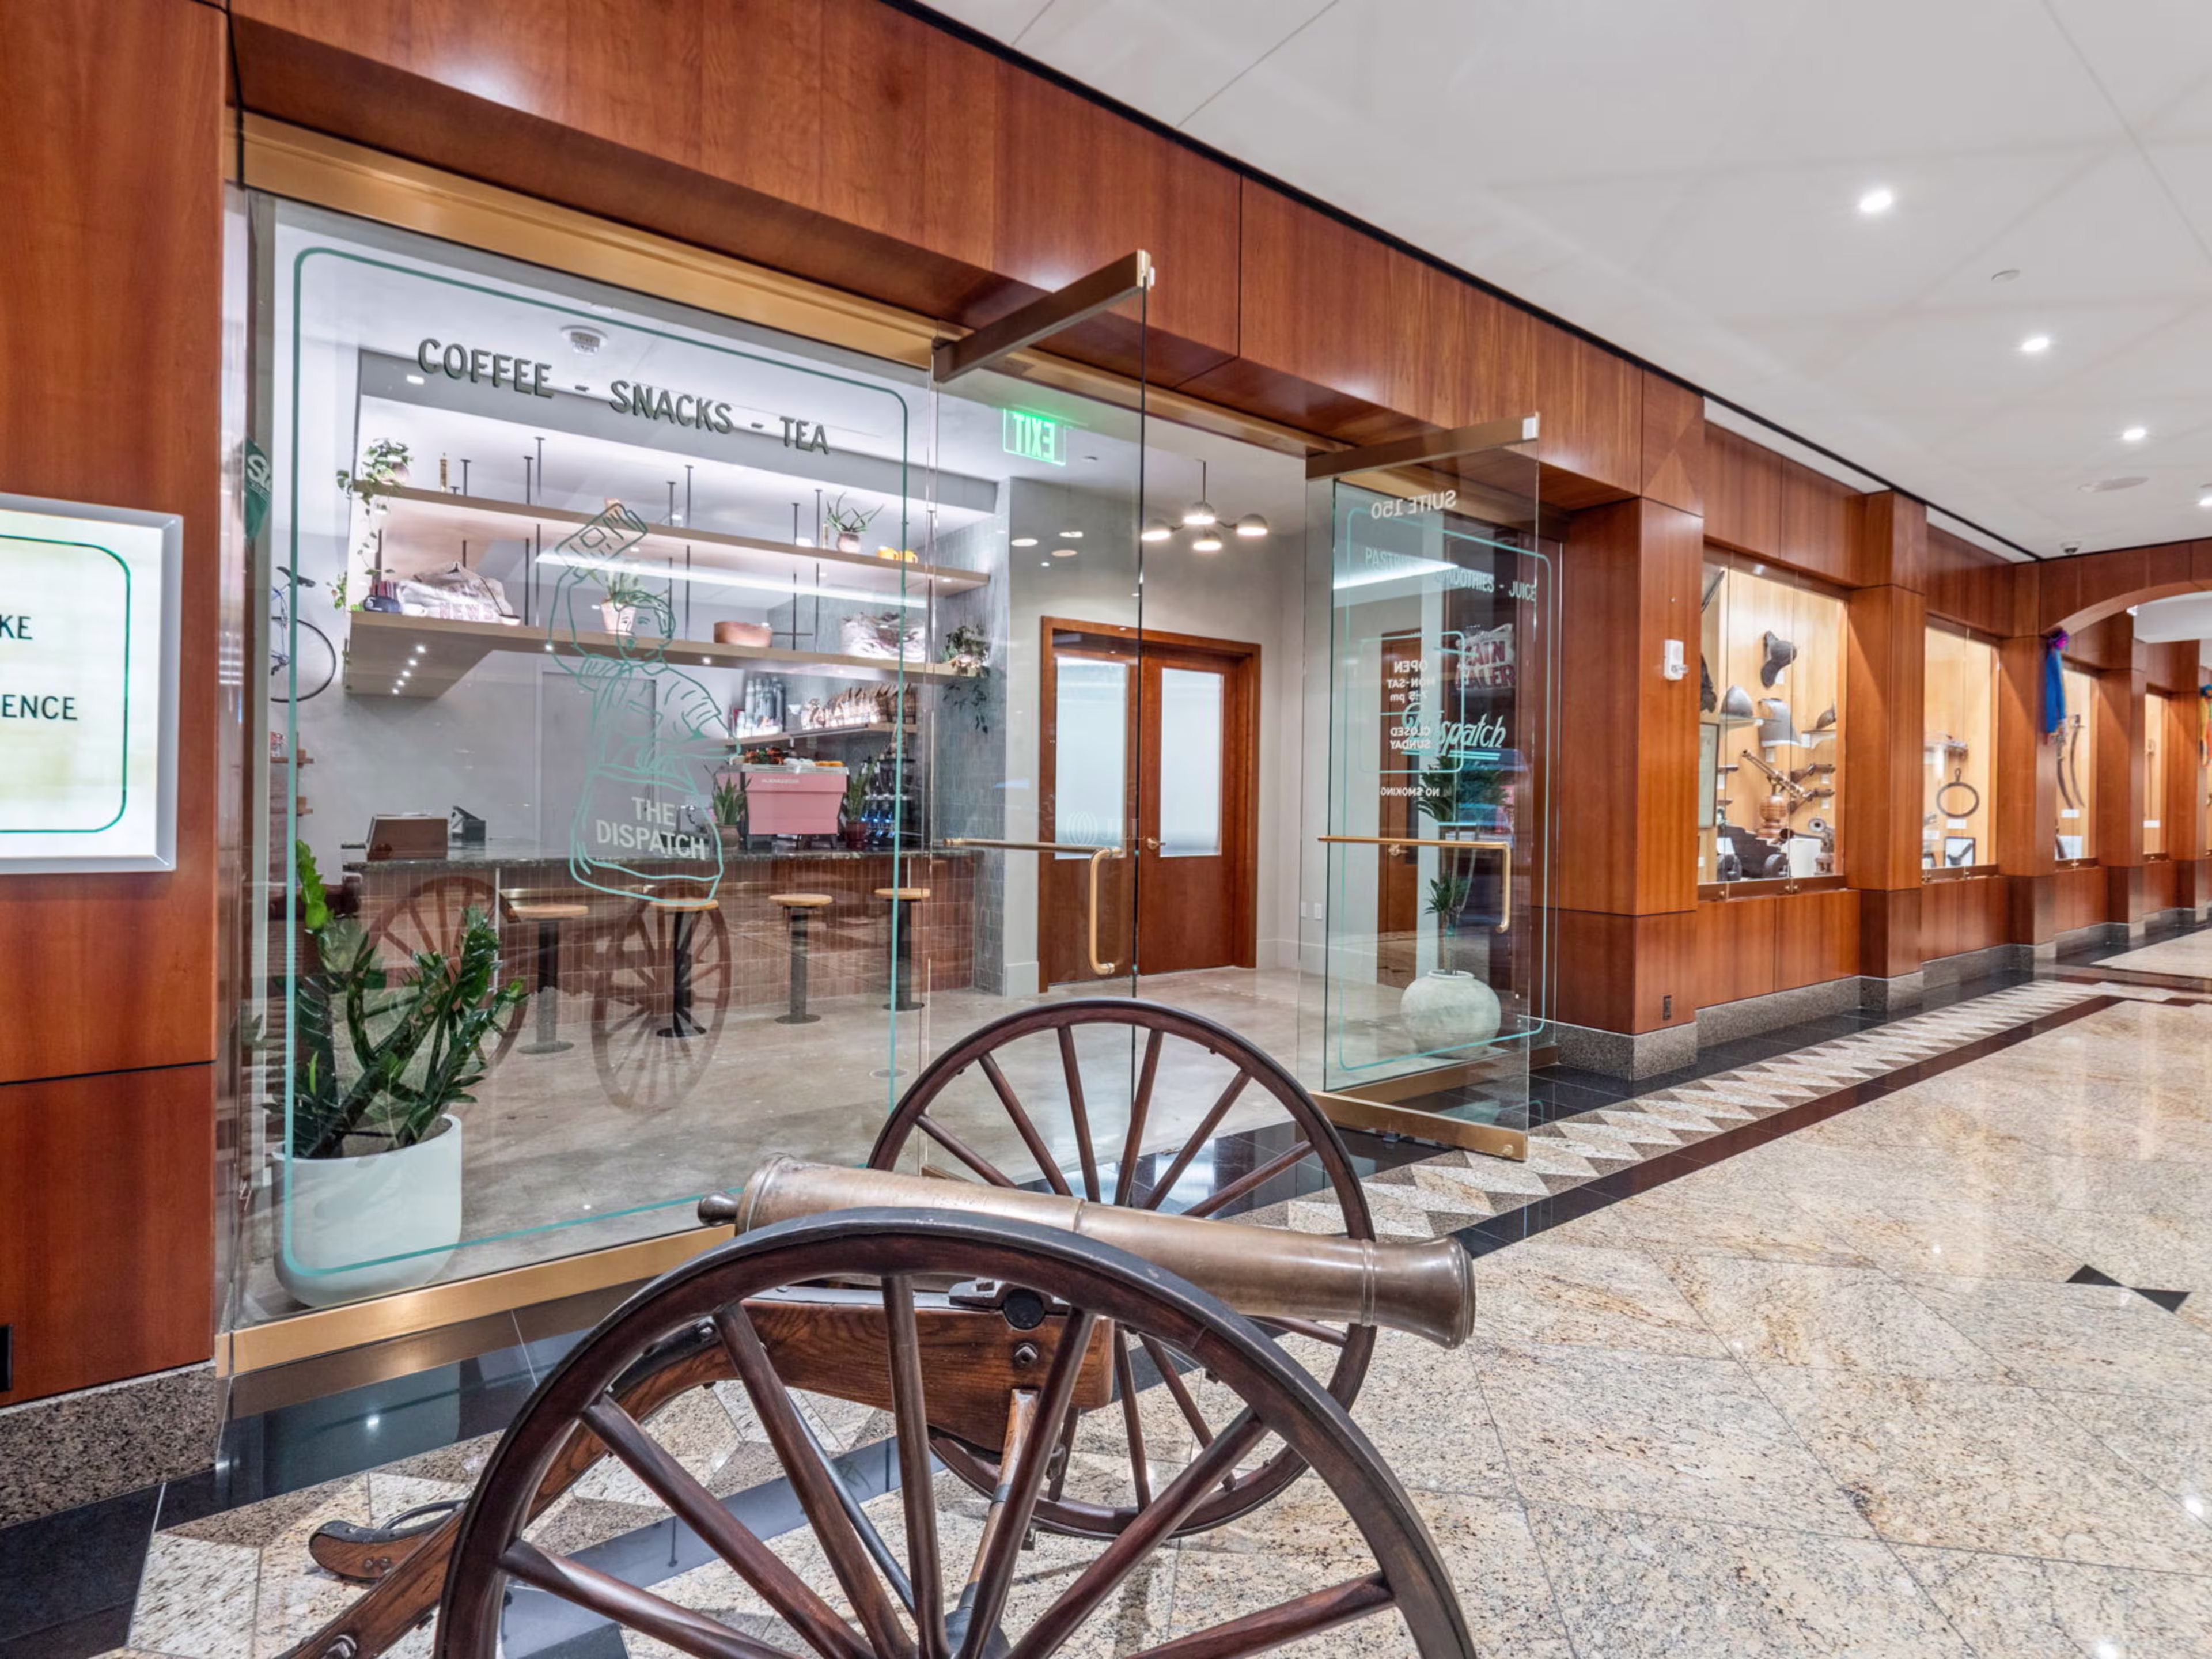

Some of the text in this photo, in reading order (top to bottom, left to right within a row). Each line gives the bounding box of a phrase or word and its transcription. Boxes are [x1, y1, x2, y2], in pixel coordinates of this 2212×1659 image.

[418, 338, 555, 399] COFFEE
[608, 380, 734, 435] SNACKS
[779, 416, 830, 456] TEA
[1508, 580, 1537, 602] JUICE
[2, 694, 78, 721] ENCE
[631, 796, 676, 827] THE
[596, 819, 706, 861] DISPATCH
